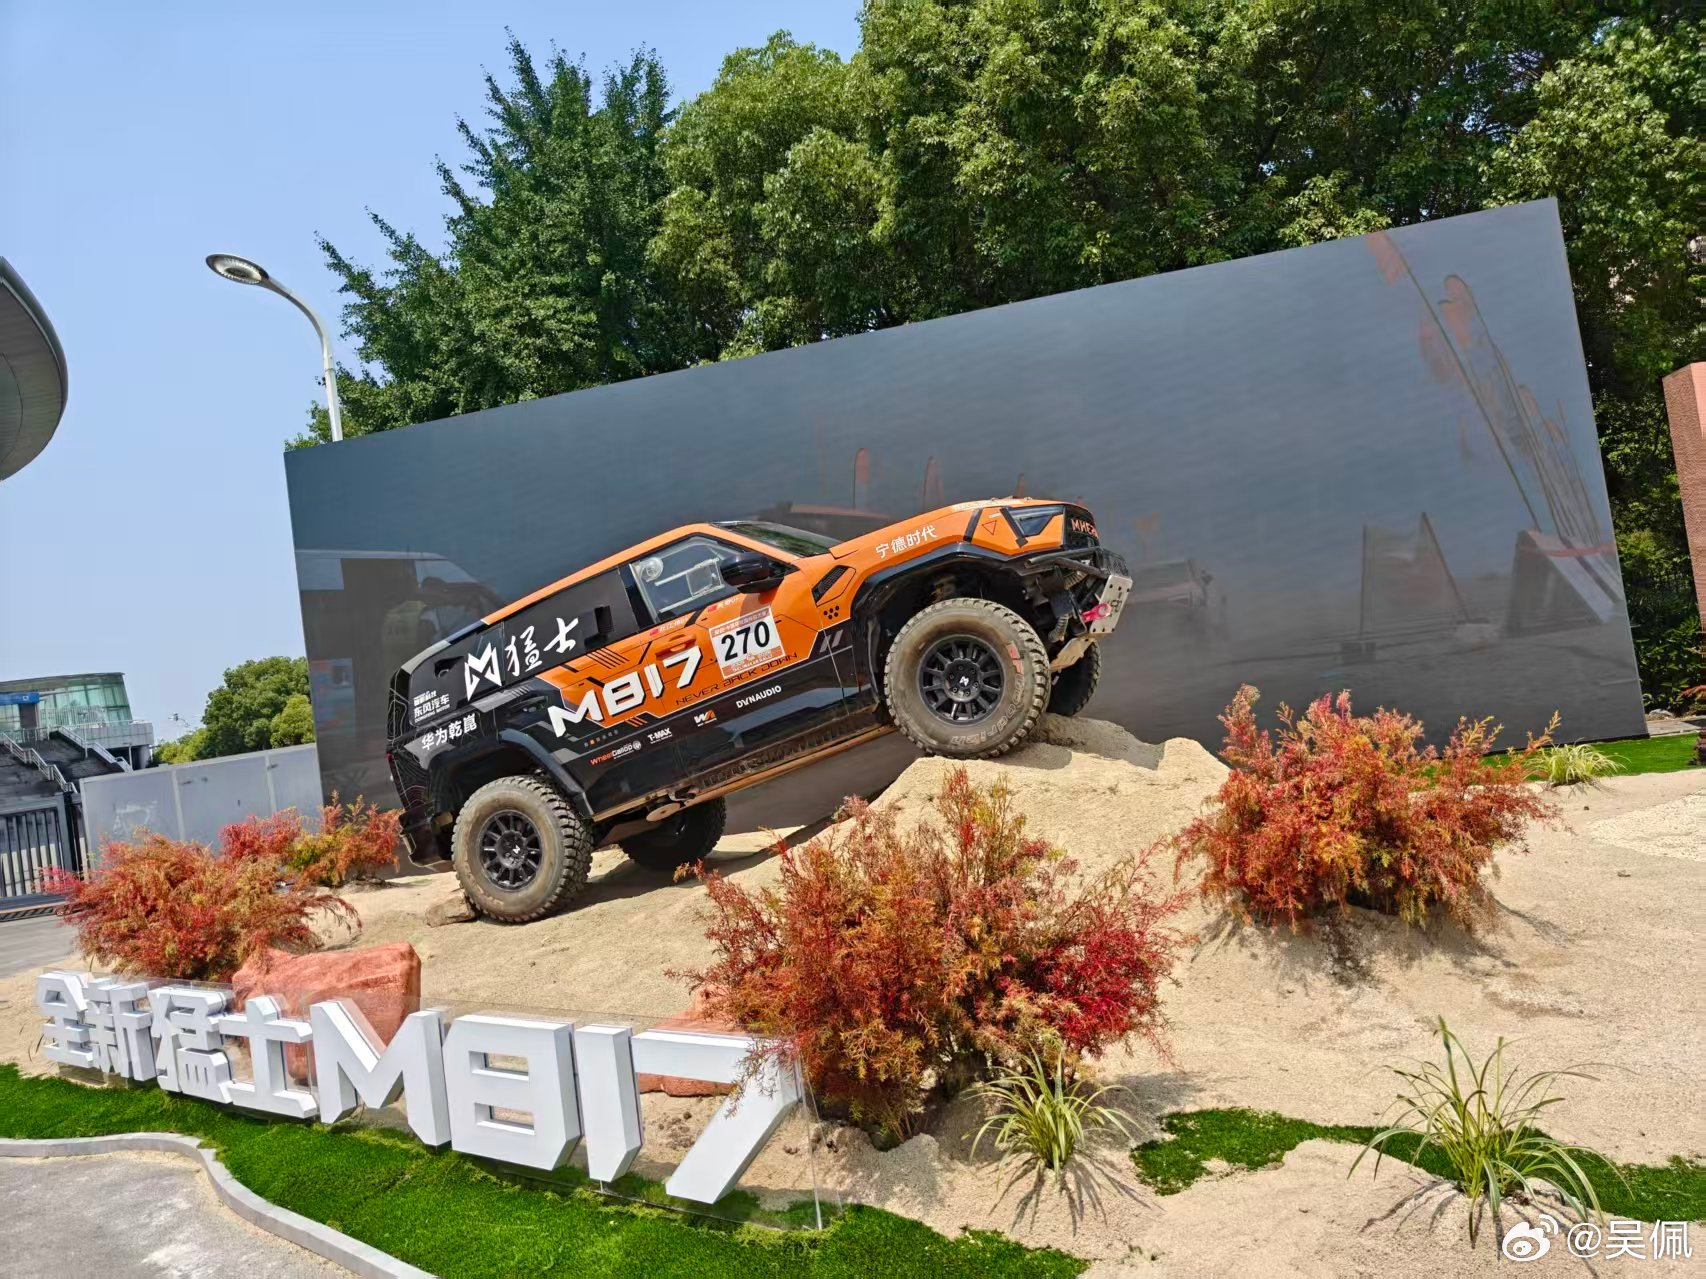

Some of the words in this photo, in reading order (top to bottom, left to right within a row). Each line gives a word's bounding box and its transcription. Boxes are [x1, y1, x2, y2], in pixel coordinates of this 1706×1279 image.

[875, 525, 937, 559] 宁德时代
[505, 617, 579, 677] 猛士
[721, 621, 770, 662] 270
[547, 646, 702, 738] M817
[676, 683, 719, 706] NEVER
[723, 669, 757, 687] BACK
[761, 652, 798, 671] DOWN
[735, 685, 782, 709] DYNAUDIO
[413, 693, 450, 719] 东风汽车
[647, 727, 672, 742] T-MAX
